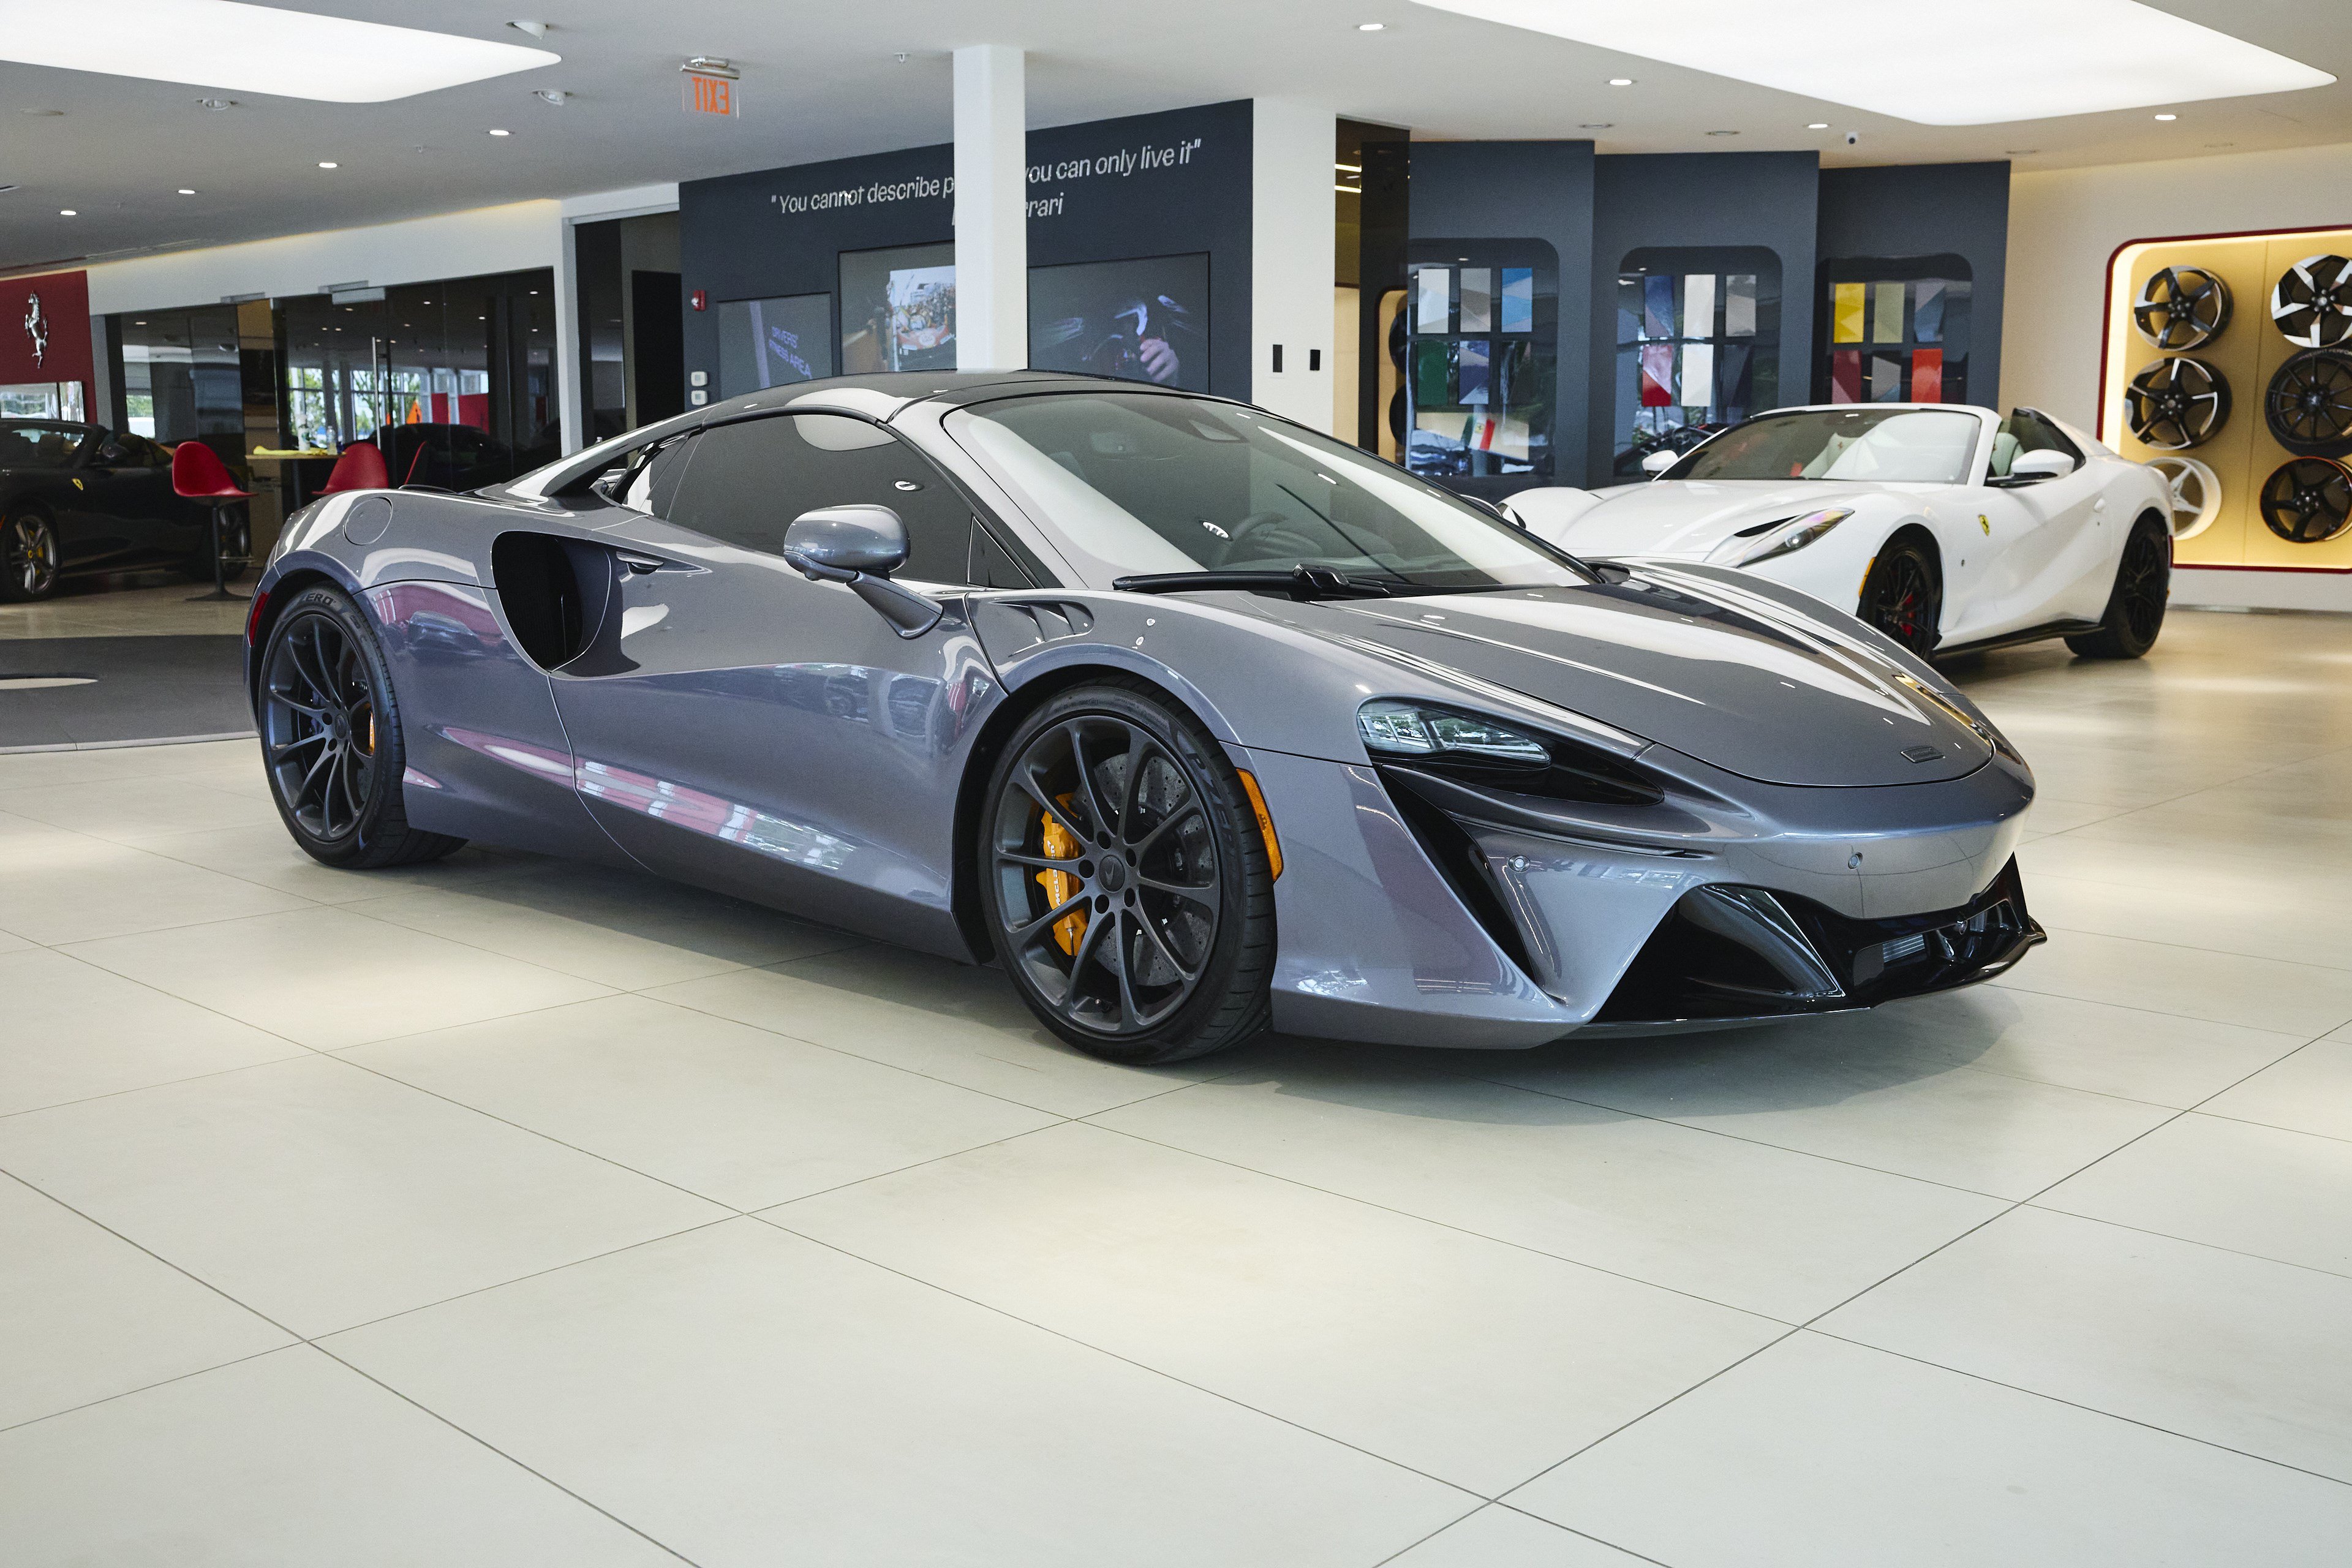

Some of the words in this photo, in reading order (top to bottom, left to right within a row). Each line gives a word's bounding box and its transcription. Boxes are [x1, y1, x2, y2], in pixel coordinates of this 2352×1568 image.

[810, 186, 865, 210] cannot
[867, 176, 940, 203] describe
[1025, 164, 1052, 183] ou
[1056, 159, 1090, 179] can
[1095, 149, 1137, 176] only
[1140, 145, 1175, 169] live
[1179, 138, 1201, 165] it"
[1026, 192, 1063, 217] rari
